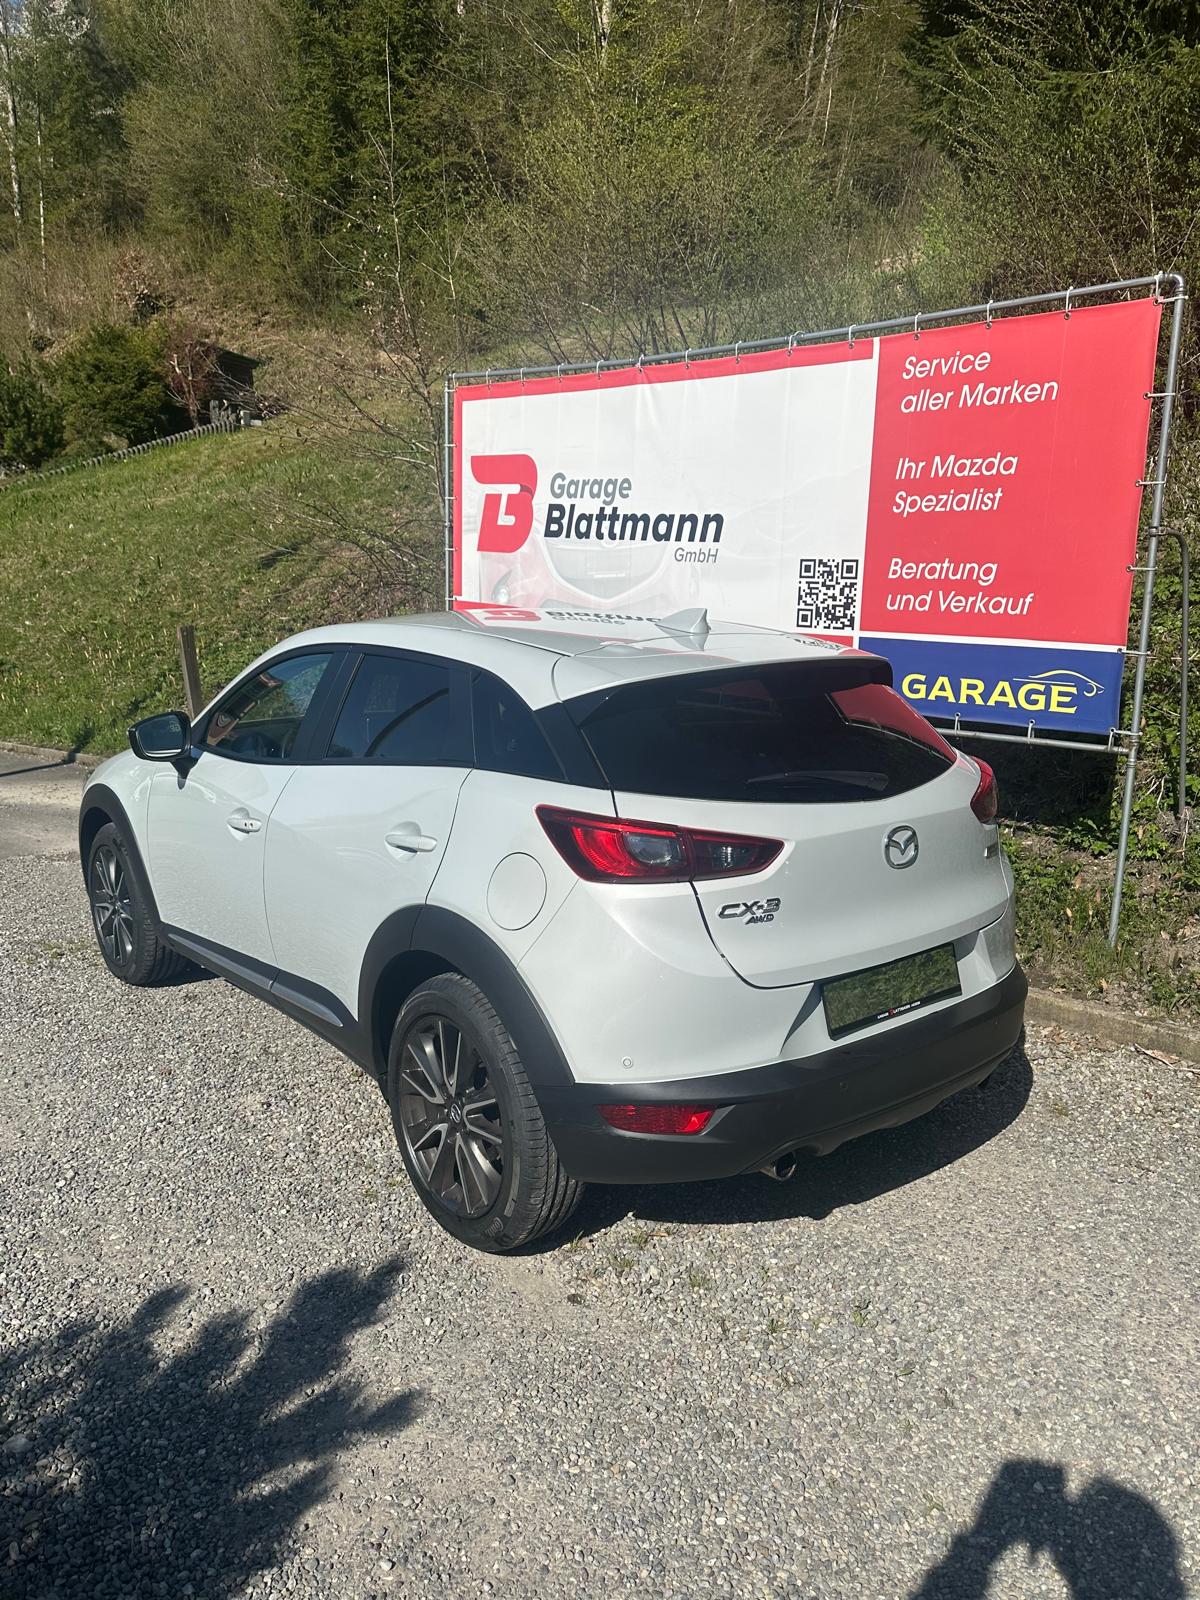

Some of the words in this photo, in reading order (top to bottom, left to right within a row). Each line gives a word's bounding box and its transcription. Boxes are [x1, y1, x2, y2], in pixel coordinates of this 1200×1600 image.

[902, 351, 991, 380] Service
[900, 390, 954, 414] aller
[958, 380, 1060, 409] Marken
[895, 457, 925, 480] Ihr
[930, 452, 1019, 478] Mazda
[550, 472, 632, 506] Garage
[892, 487, 1003, 517] Spezialist
[544, 503, 724, 543] Blattmann
[674, 547, 719, 564] GmbH
[888, 558, 998, 586] Beratung
[886, 590, 933, 612] und
[938, 590, 1034, 616] Verkauf
[901, 673, 1079, 714] GARAGE
[718, 897, 782, 919] CX-3
[745, 913, 775, 925] AWD
